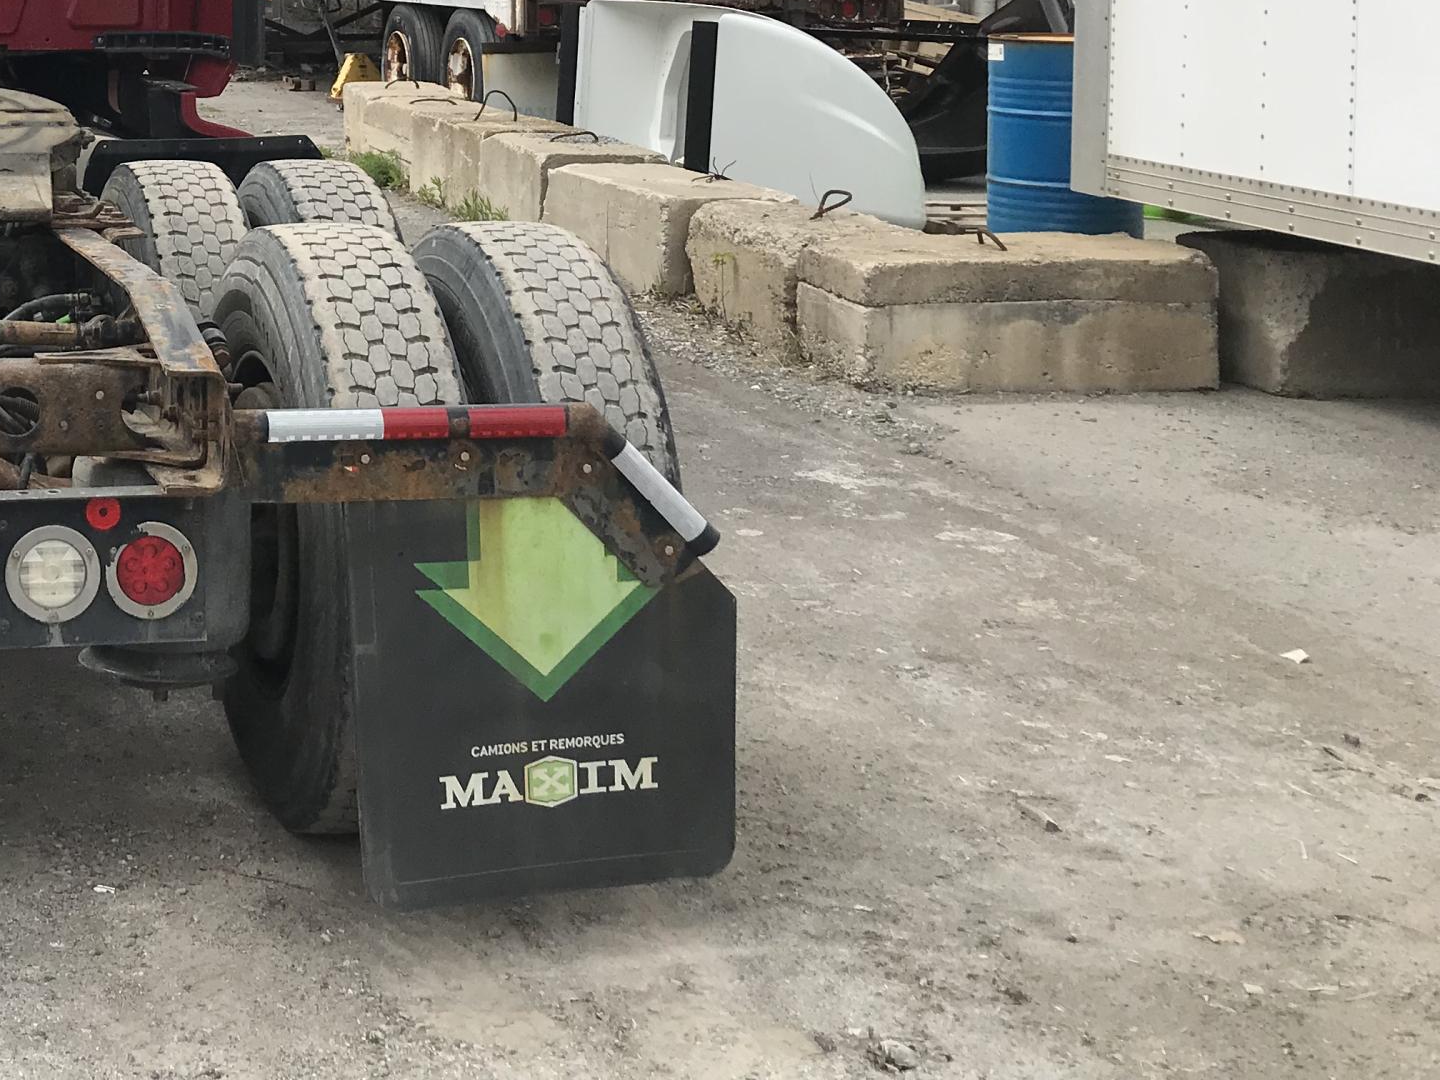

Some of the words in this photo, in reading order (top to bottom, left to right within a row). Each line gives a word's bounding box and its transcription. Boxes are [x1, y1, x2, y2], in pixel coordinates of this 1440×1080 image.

[471, 741, 528, 757] CAMIONS
[531, 739, 548, 752] ET
[549, 733, 625, 751] REMORQUES
[439, 755, 658, 809] MAXIM
